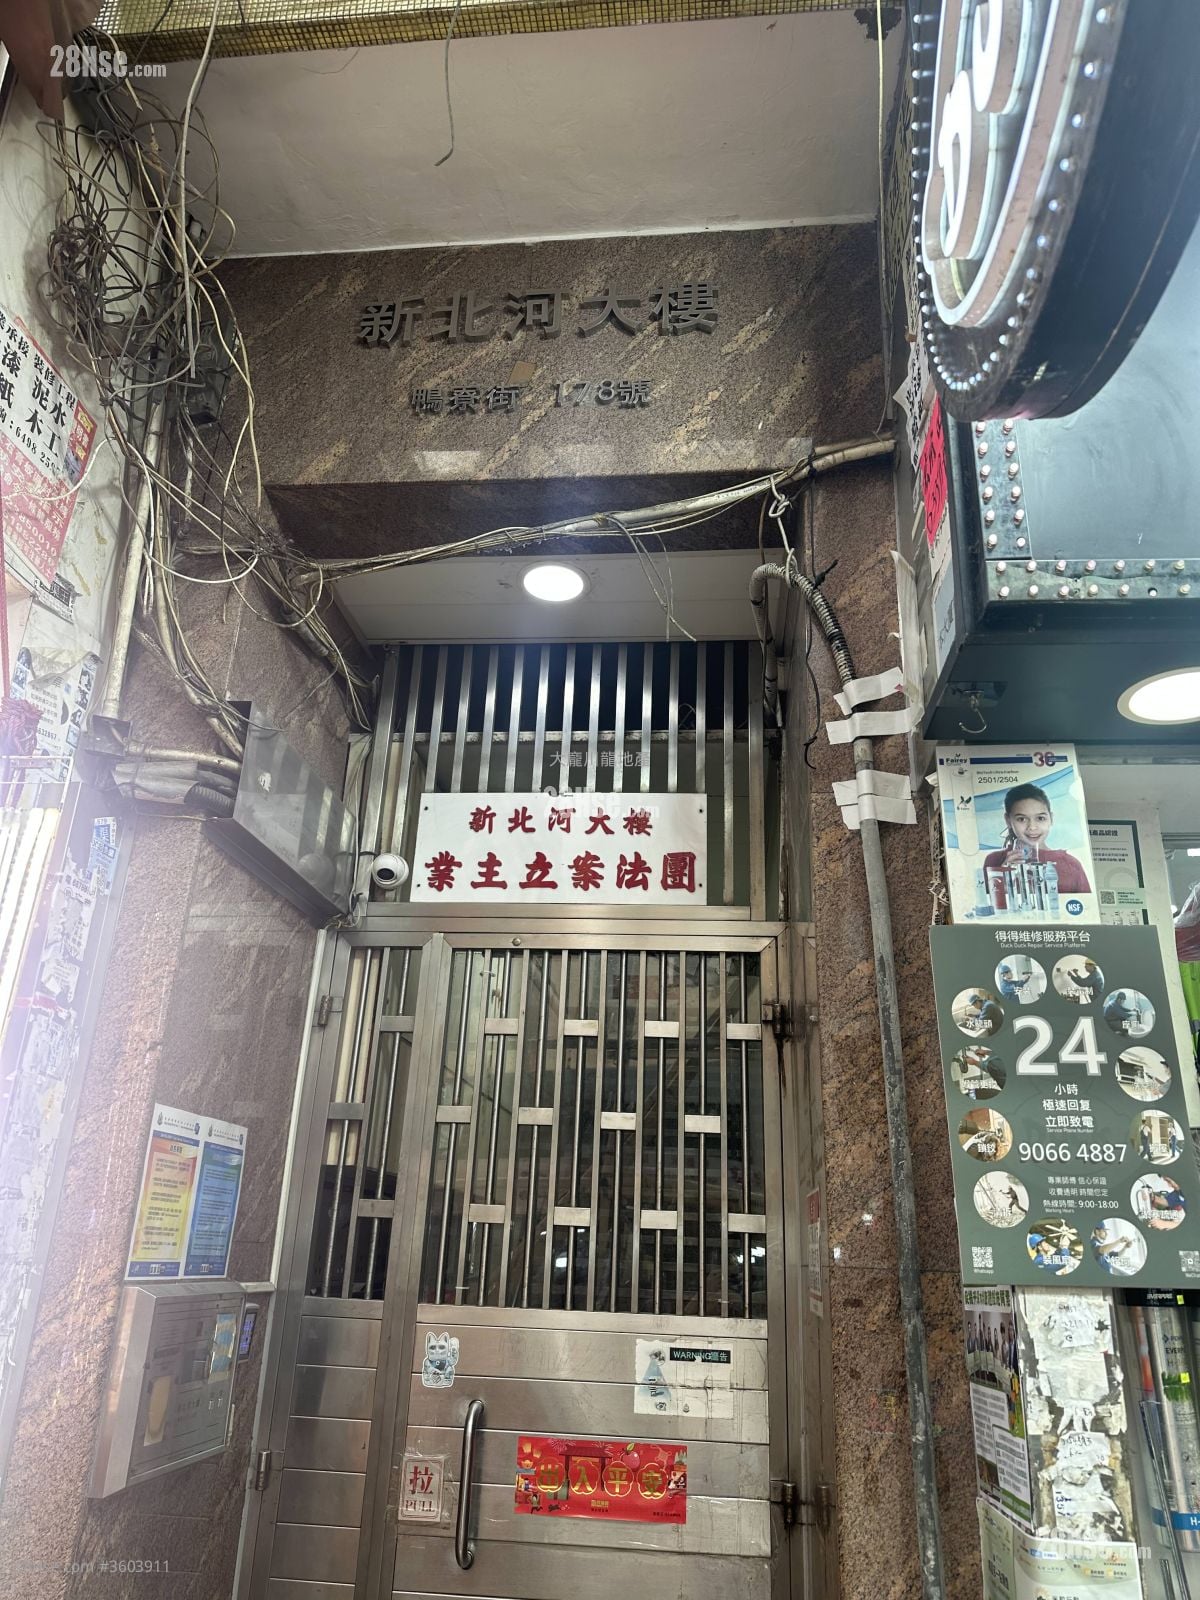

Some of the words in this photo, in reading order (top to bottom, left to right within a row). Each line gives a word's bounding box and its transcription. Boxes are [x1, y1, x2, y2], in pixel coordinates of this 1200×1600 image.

[358, 283, 719, 347] 新北河大樓
[32, 376, 66, 427] 泥水
[411, 385, 523, 414] 鴨寮街
[553, 379, 652, 408] 178號
[25, 407, 61, 458] 木工
[978, 776, 1018, 784] 2501/2504
[468, 804, 653, 837] 新北河大樓
[424, 850, 697, 893] 業主立案法團
[995, 929, 1091, 943] 得得維修服務平台
[1012, 1015, 1108, 1076] 24
[1054, 1083, 1078, 1096] 小時
[1045, 1116, 1095, 1128] 立即致電
[1019, 1142, 1071, 1162] 9066
[1076, 1143, 1127, 1163] 4887
[409, 1466, 435, 1495] 拉
[538, 1464, 663, 1497] 出入平安
[405, 1499, 433, 1513] PULL
